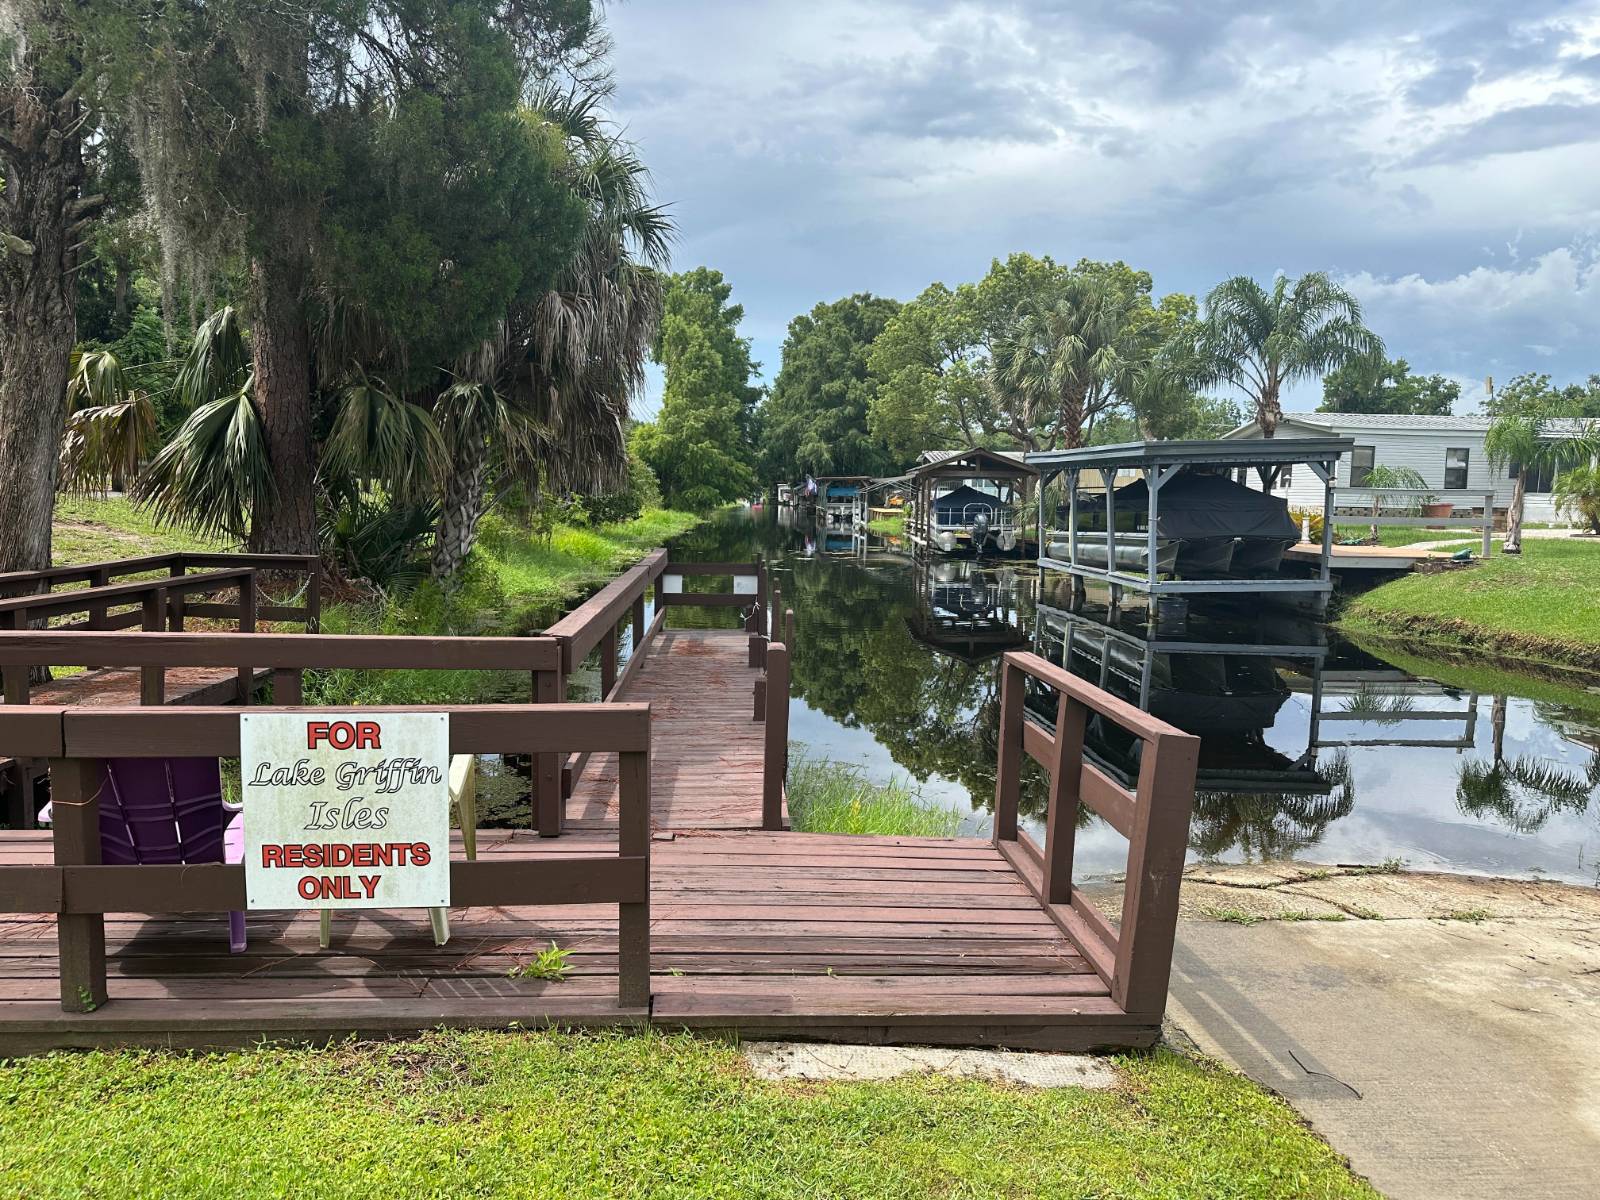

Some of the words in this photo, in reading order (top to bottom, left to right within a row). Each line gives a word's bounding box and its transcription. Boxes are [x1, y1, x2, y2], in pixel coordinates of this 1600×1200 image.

[307, 721, 381, 749] FOR
[249, 759, 325, 786] Lake
[335, 758, 442, 793] Griffin
[304, 797, 389, 830] Isles
[262, 842, 431, 868] RESIDENTS
[298, 875, 381, 899] ONLY
